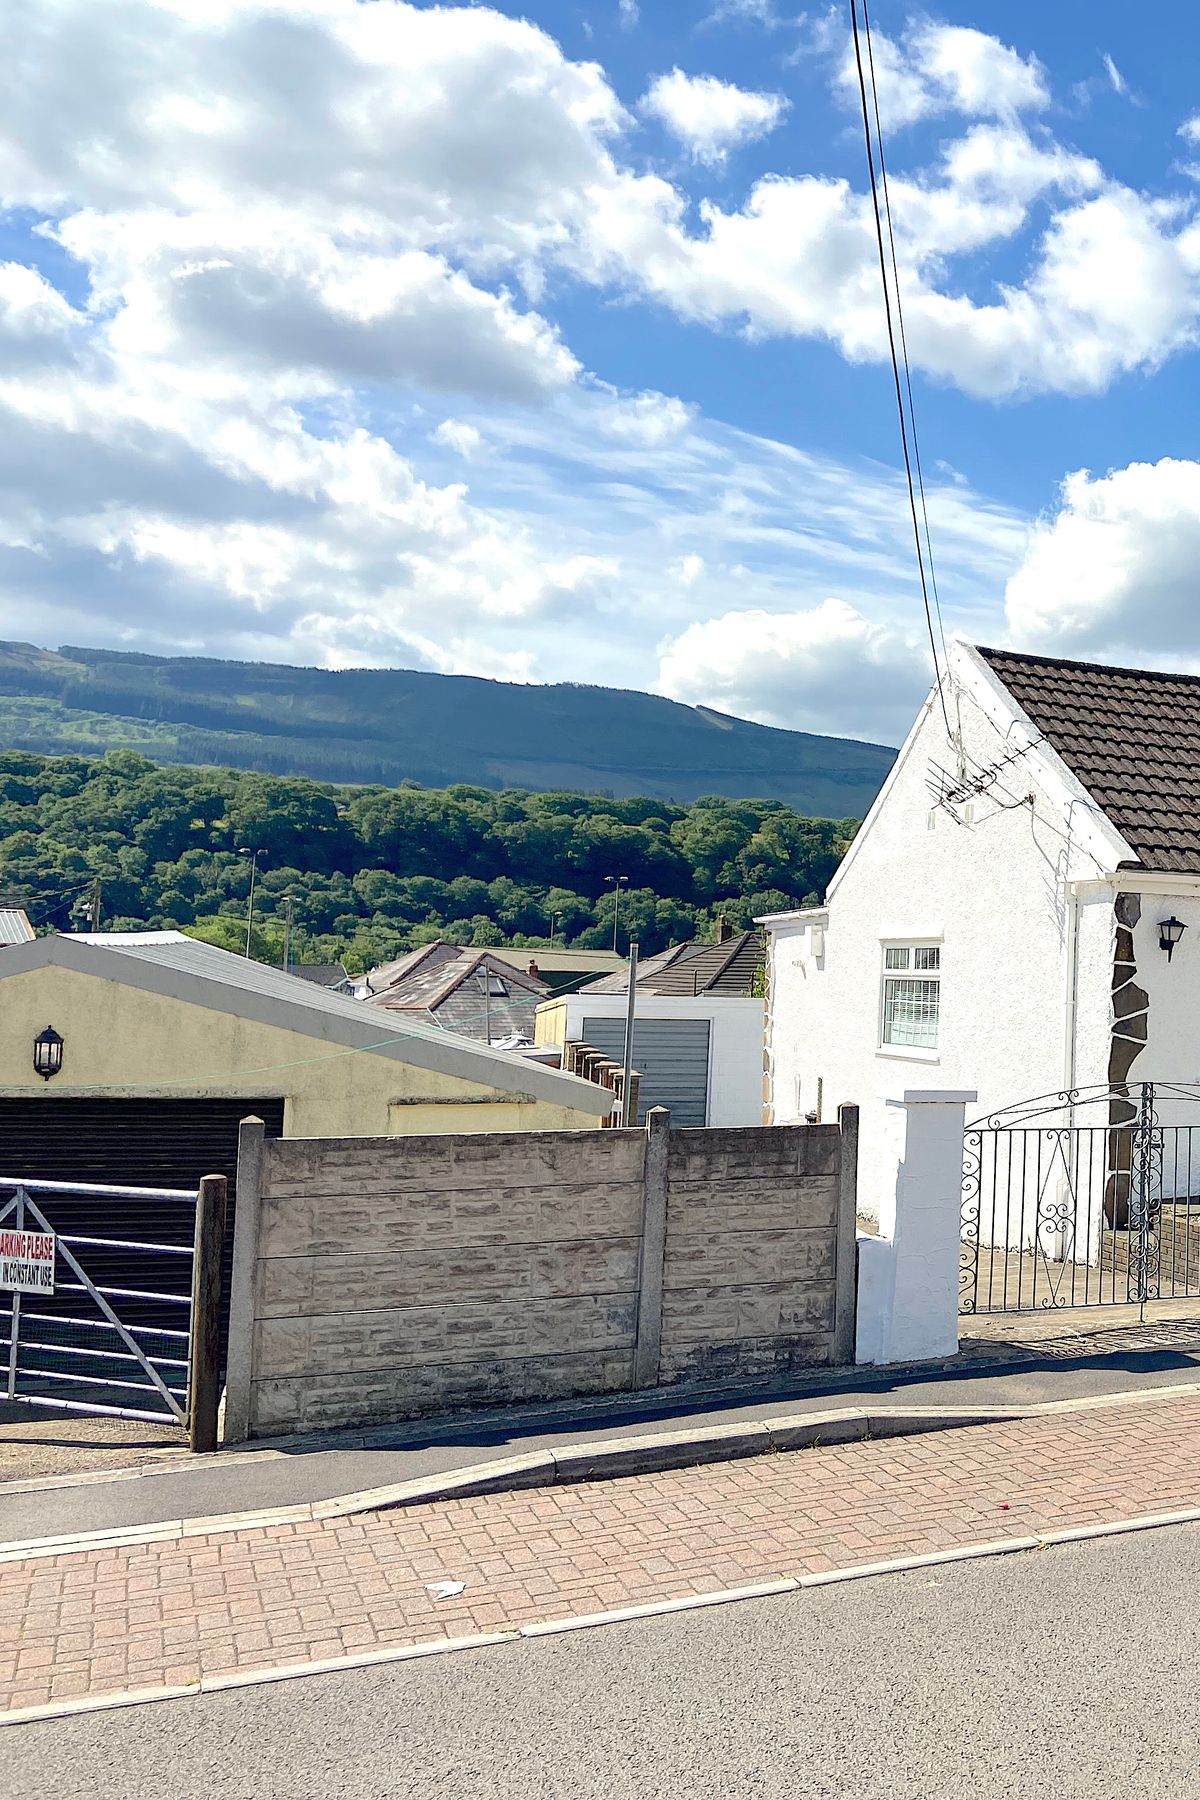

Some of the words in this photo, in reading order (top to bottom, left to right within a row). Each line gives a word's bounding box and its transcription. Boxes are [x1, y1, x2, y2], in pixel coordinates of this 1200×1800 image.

[0, 1233, 26, 1258] ARKING
[27, 1235, 53, 1260] PLEASE
[3, 1262, 9, 1283] IN
[10, 1262, 40, 1286] CONSTANT
[40, 1265, 52, 1287] USE
